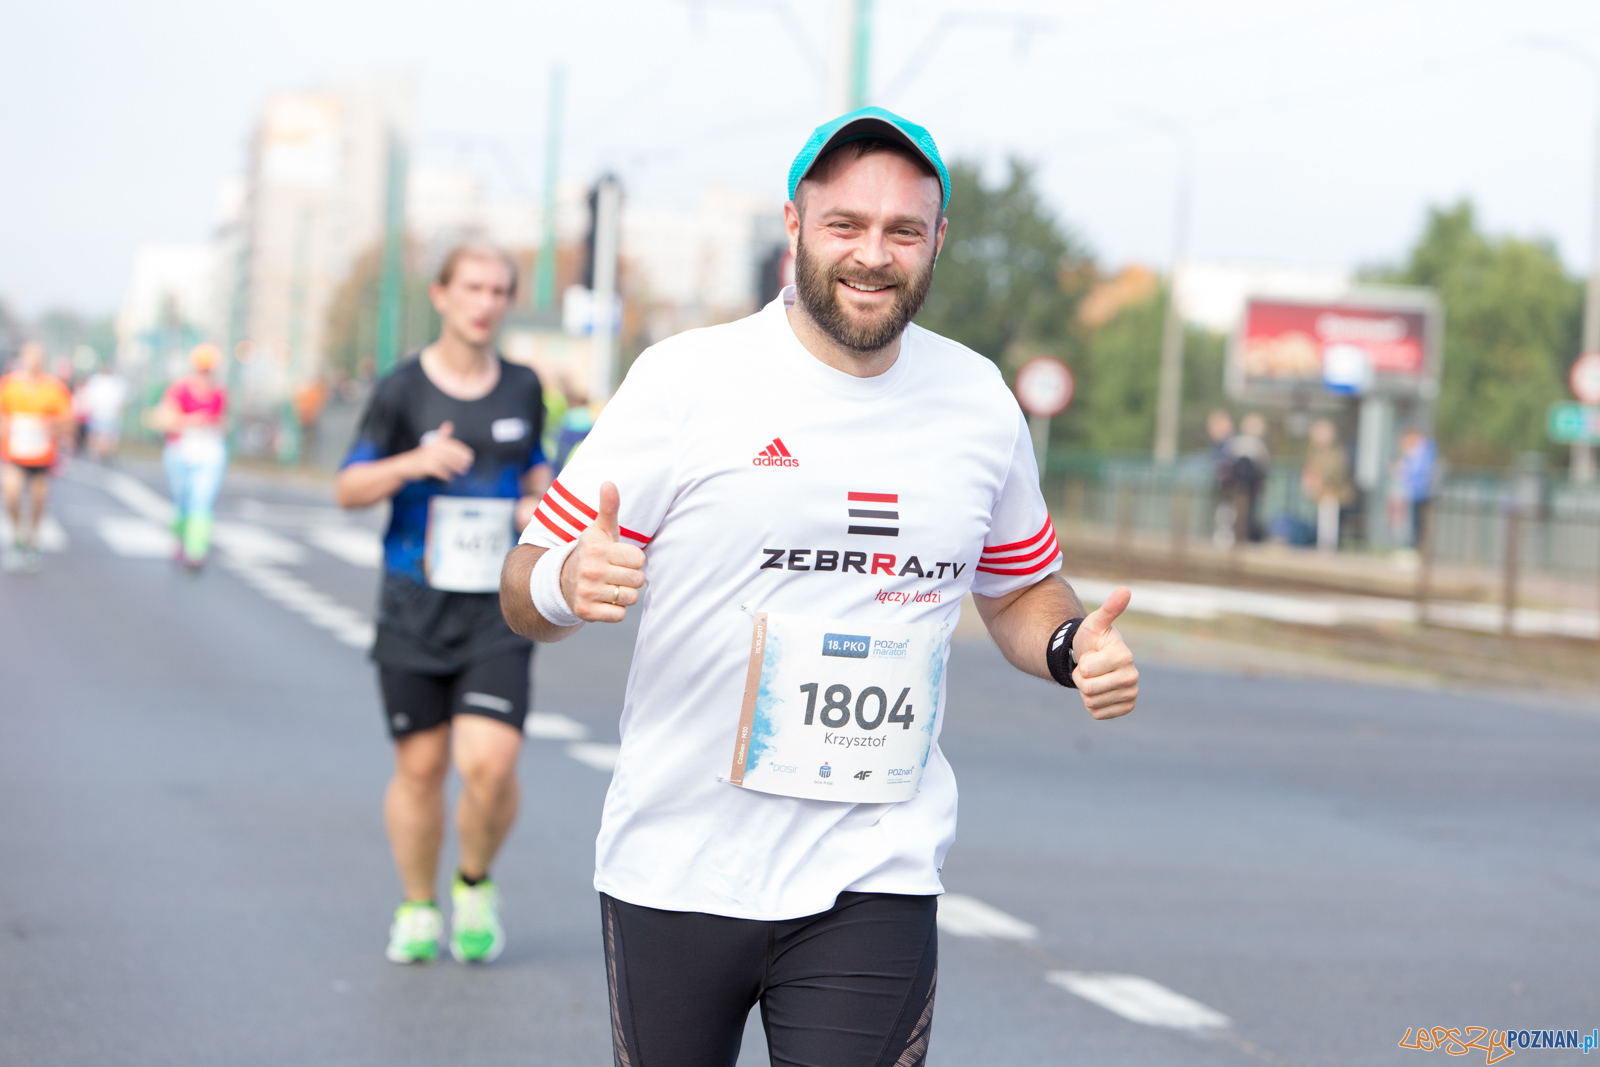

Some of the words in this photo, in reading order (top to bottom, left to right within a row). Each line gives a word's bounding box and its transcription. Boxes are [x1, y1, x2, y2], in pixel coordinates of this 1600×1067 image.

[752, 456, 800, 467] adidas
[760, 548, 967, 580] ZEBRRA.TV
[874, 588, 911, 606] łączy
[912, 590, 942, 604] ludzi
[755, 625, 764, 654] 15.10.2017
[827, 640, 841, 650] 18.
[843, 641, 866, 652] PKO
[872, 648, 907, 656] maraton
[799, 682, 915, 731] 1804
[741, 726, 749, 739] M30
[824, 732, 887, 748] Krzysztof
[853, 770, 873, 781] 4F
